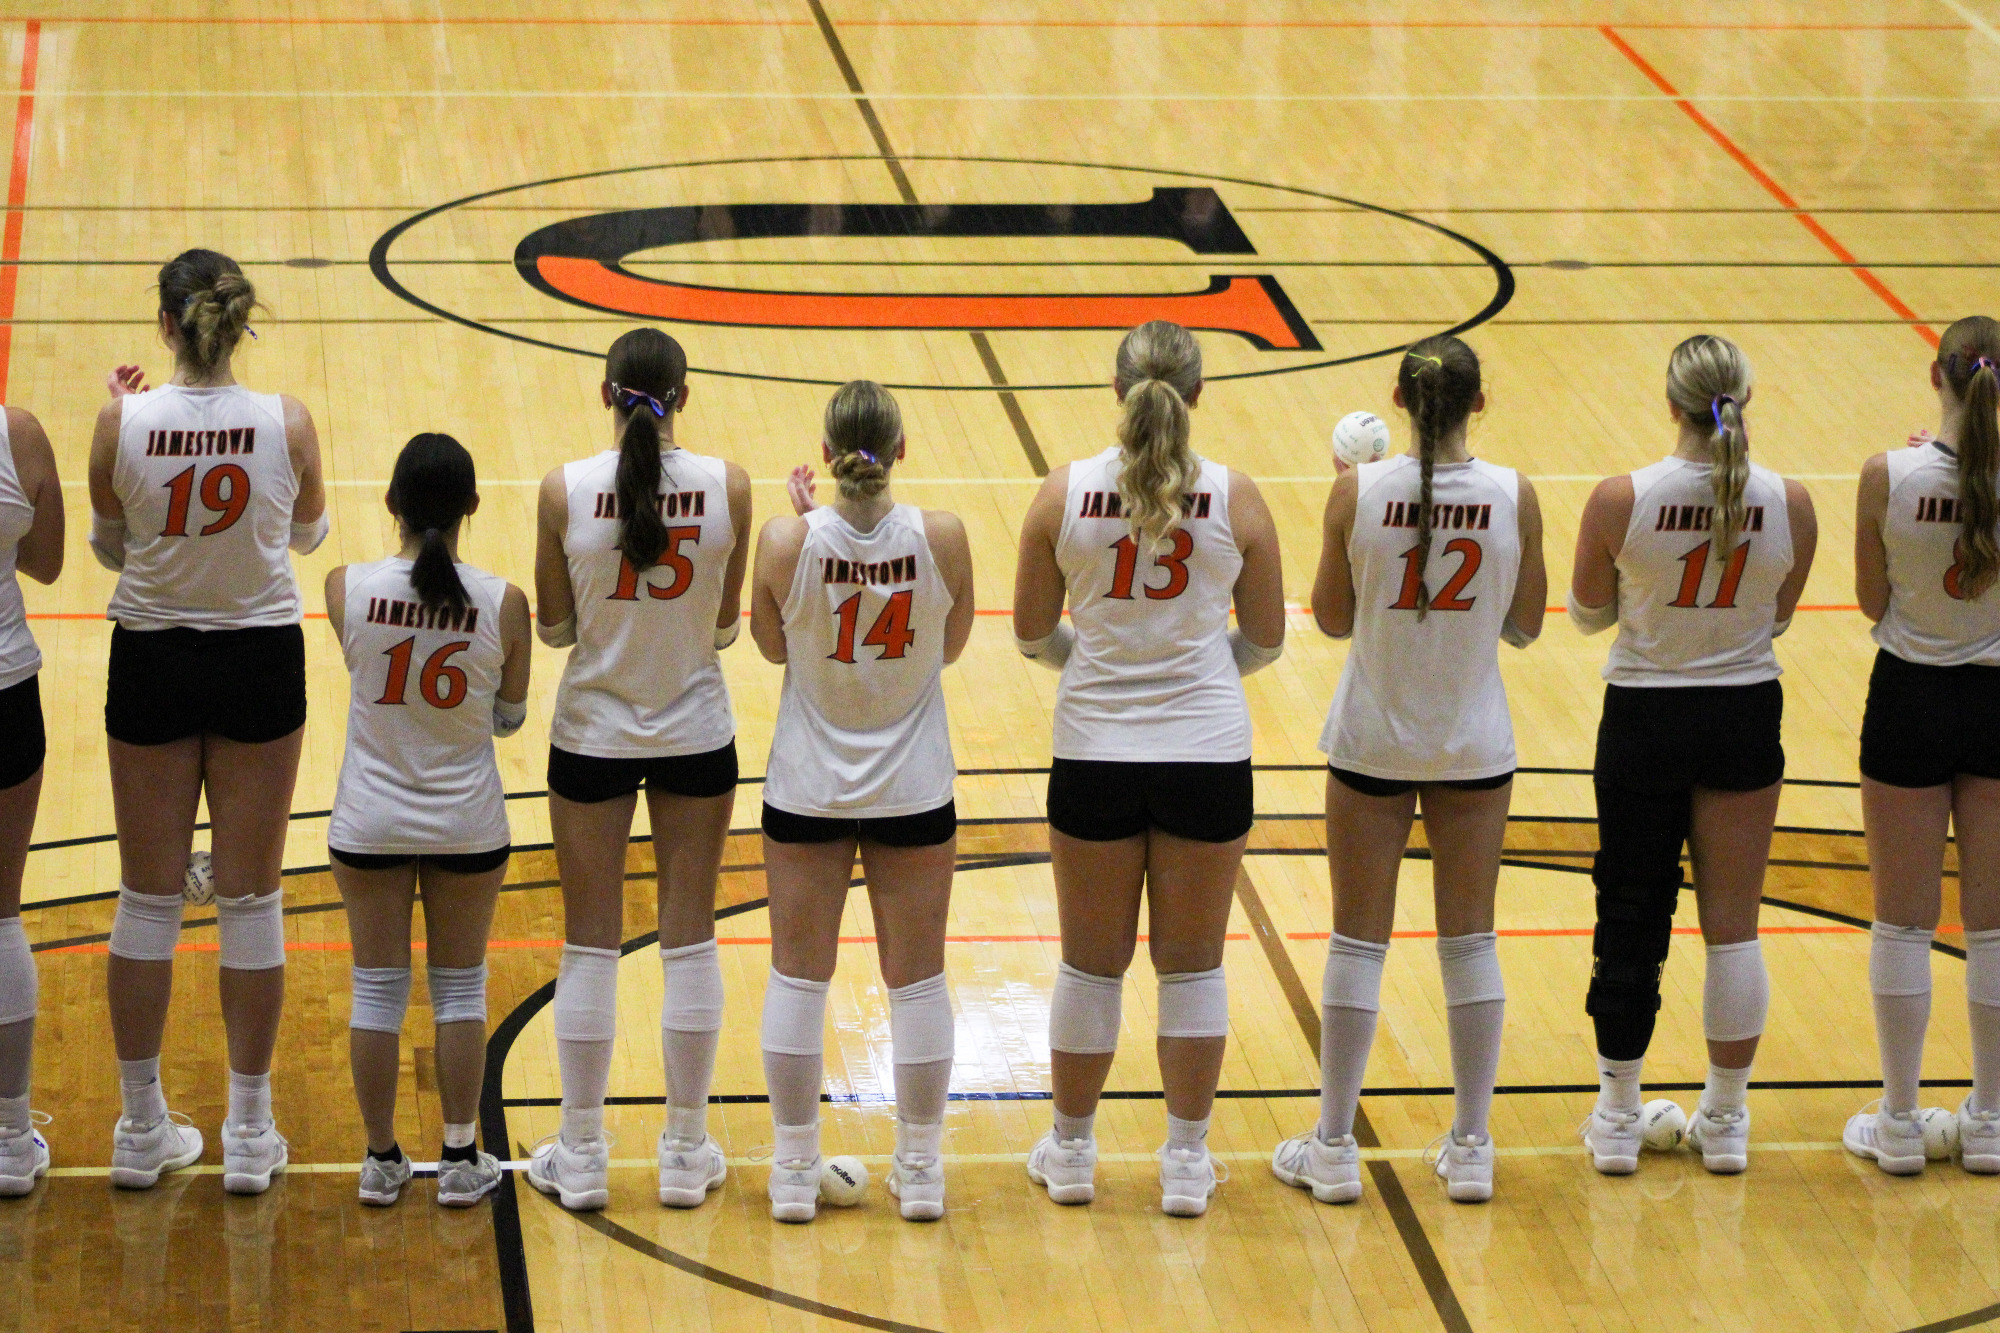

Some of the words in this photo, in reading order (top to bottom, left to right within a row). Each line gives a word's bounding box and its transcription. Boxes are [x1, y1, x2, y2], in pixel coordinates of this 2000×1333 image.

[146, 427, 255, 456] JAMESTOWN
[158, 463, 250, 537] 19
[593, 490, 705, 519] JATOWN
[1079, 491, 1211, 519] JAMWN
[1382, 501, 1492, 531] JAMSTOWN
[1655, 505, 1764, 532] JAMESN
[605, 525, 702, 601] 15
[819, 554, 917, 586] AMESTOWN
[1102, 526, 1194, 600] 13
[1387, 537, 1483, 611] 12
[1665, 538, 1751, 608] 11
[826, 589, 916, 664] 14
[373, 635, 471, 709] 16
[830, 1164, 856, 1188] molten
